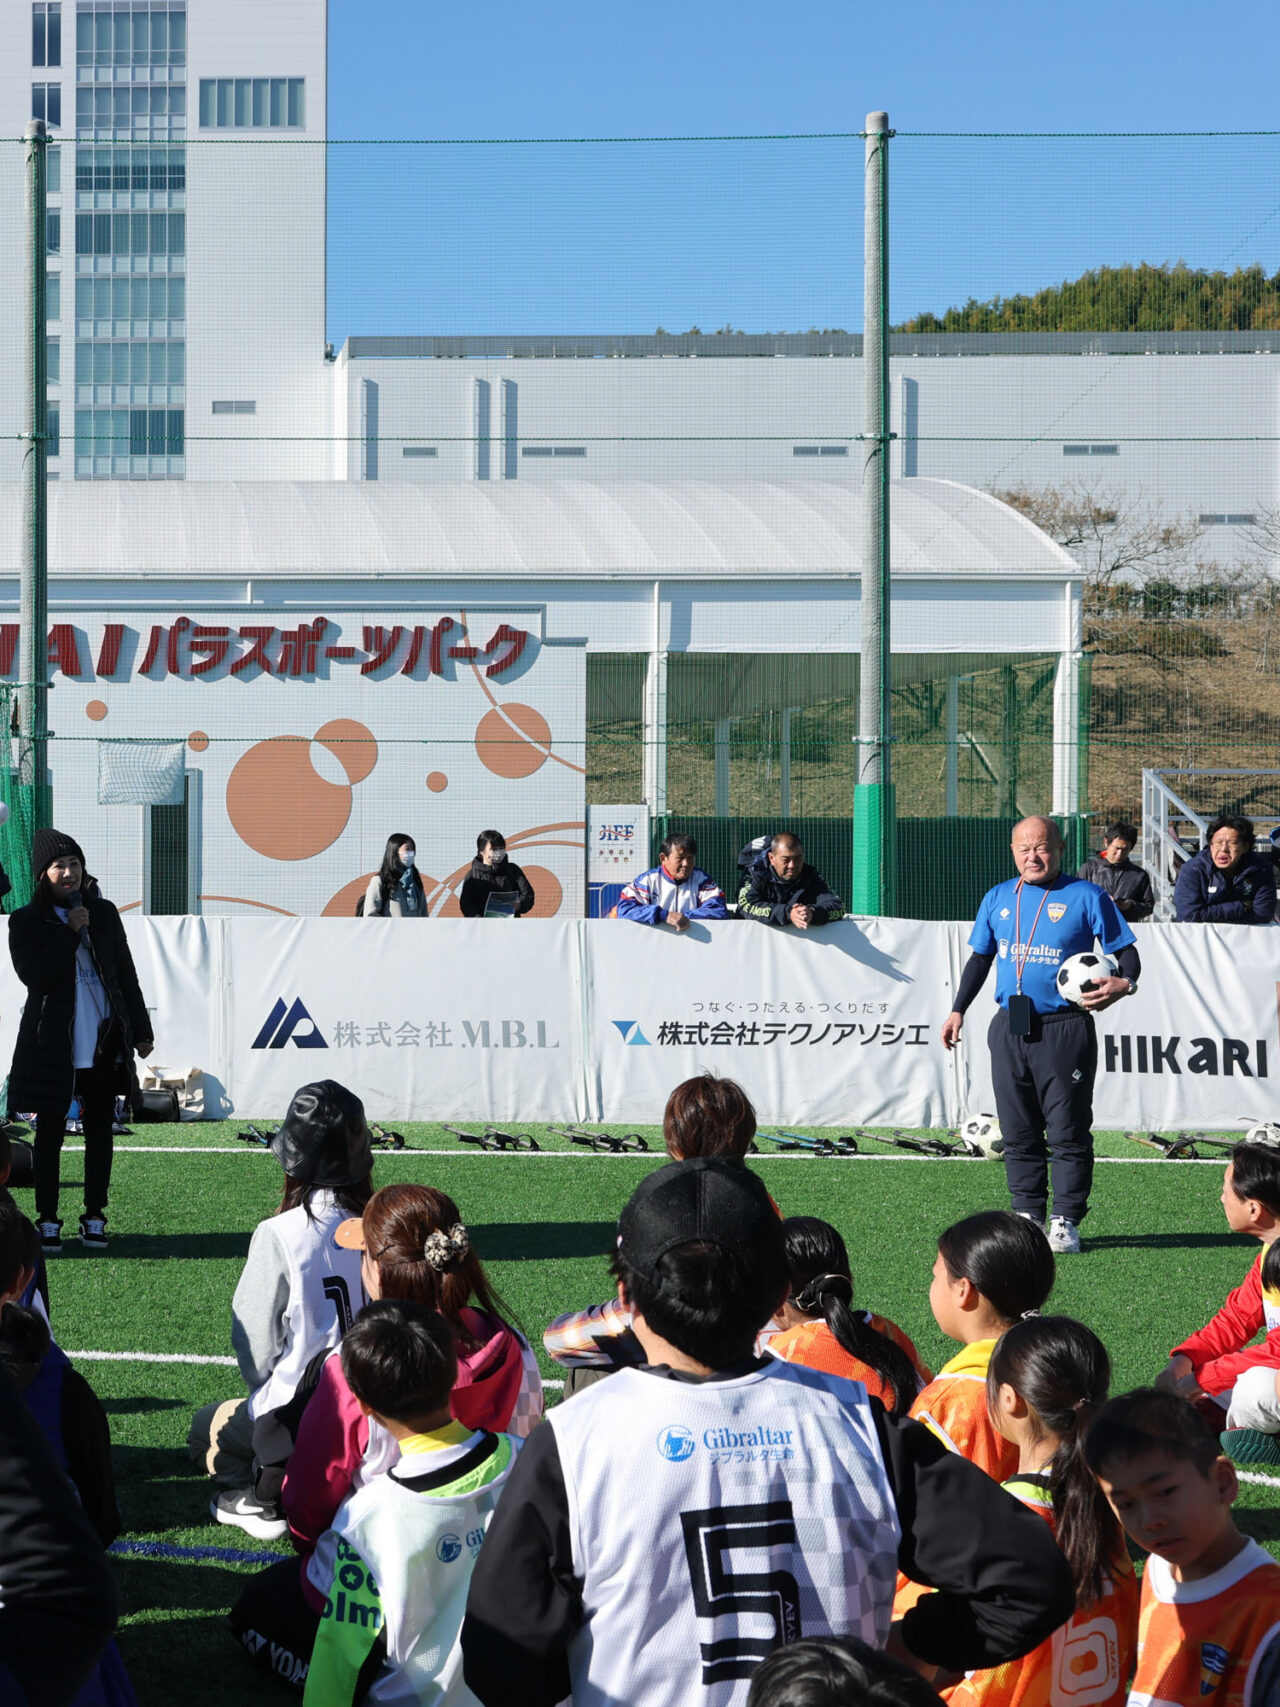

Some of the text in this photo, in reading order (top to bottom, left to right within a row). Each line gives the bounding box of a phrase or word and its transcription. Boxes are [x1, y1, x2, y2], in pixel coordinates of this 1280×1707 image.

[657, 1020, 930, 1046] 株式会社テクノアソシエ
[703, 1425, 794, 1450] Gibraltar
[709, 1447, 795, 1465] ジブラルタ生命
[679, 1500, 802, 1686] 5
